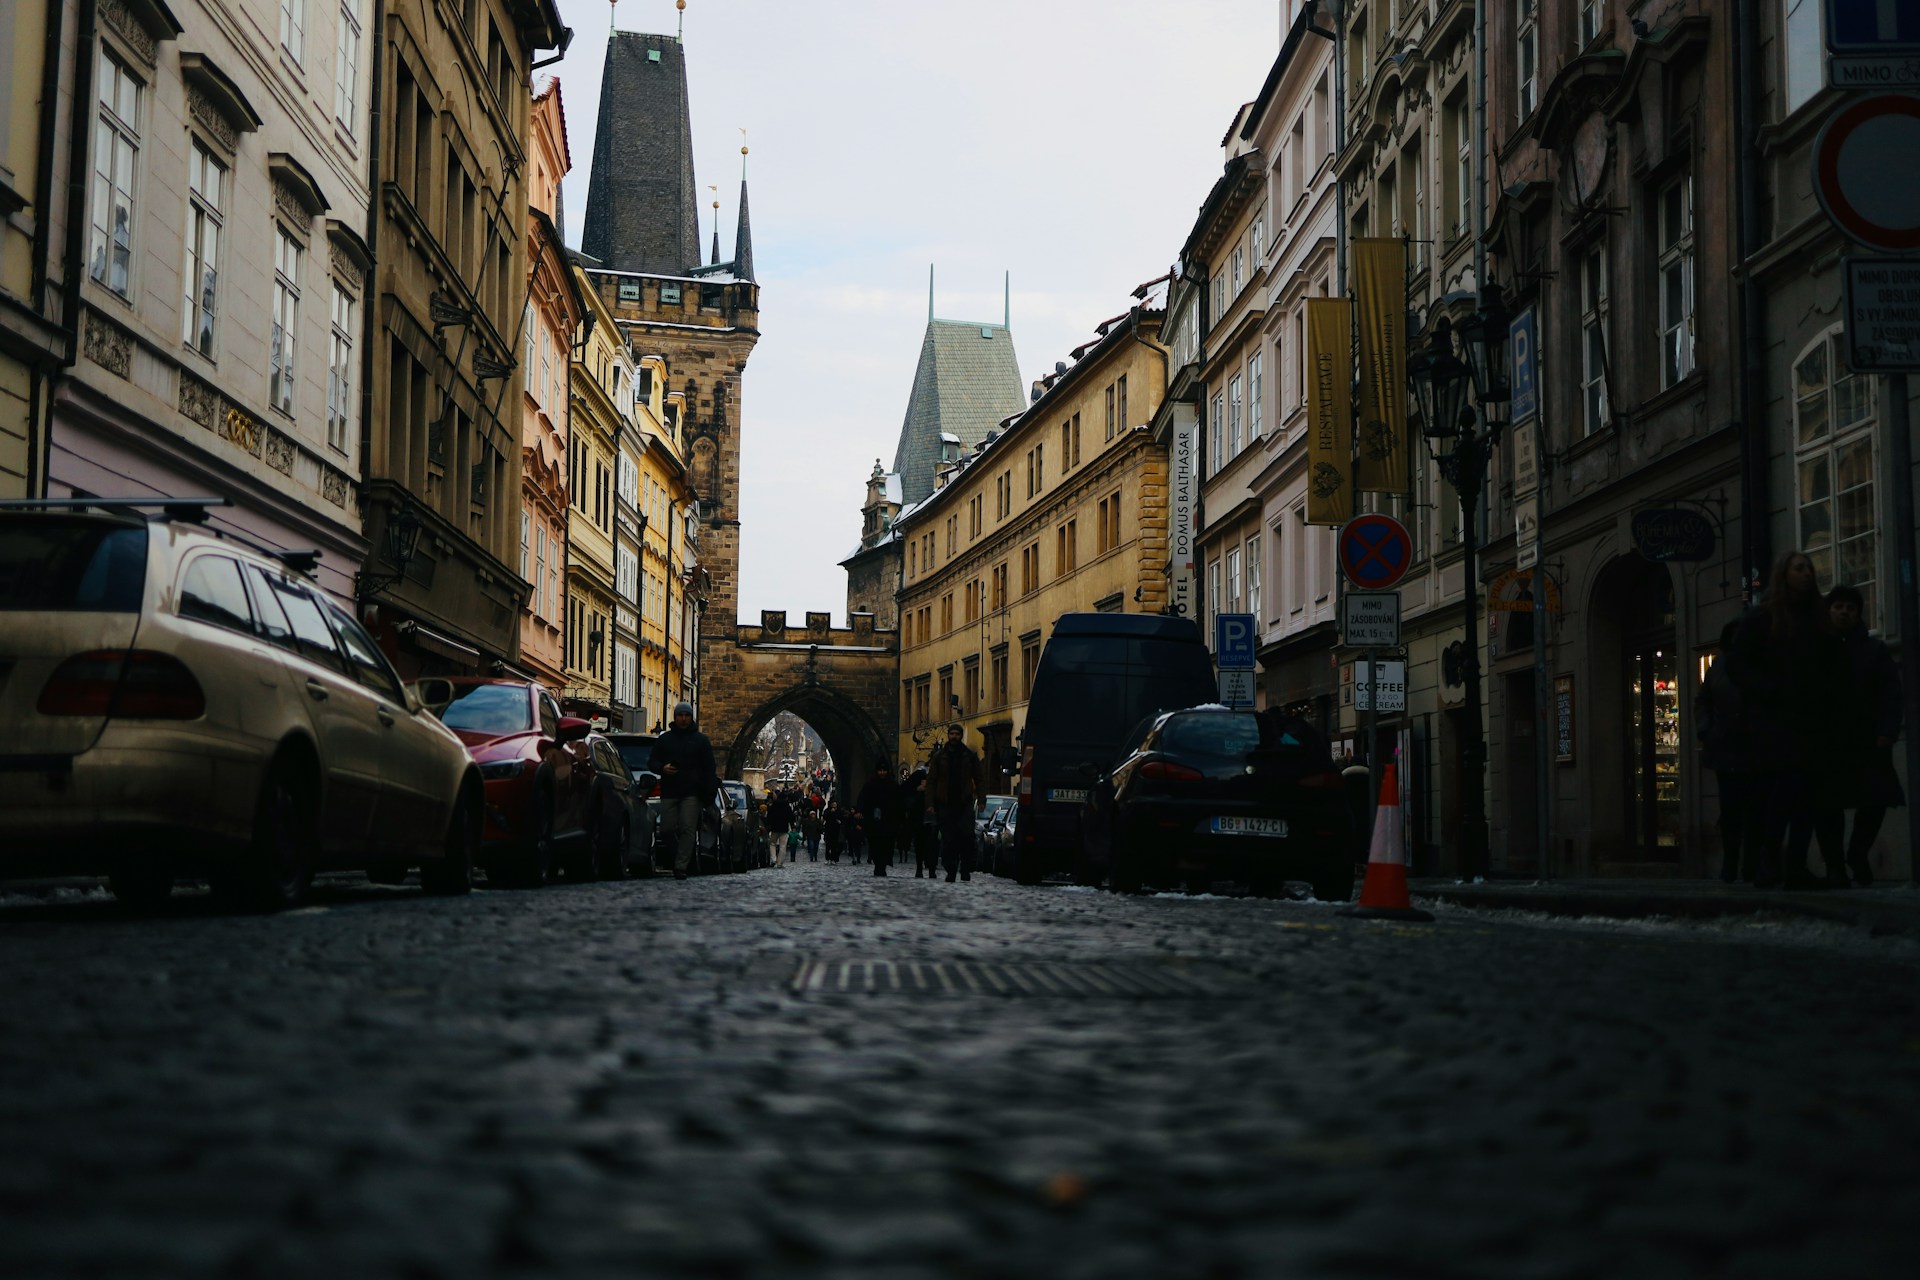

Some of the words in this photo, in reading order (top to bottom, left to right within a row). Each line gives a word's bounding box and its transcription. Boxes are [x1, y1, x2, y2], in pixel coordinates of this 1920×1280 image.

[1843, 65, 1890, 81] MIMO
[1858, 270, 1888, 284] MIMO
[1857, 308, 1864, 322] S
[1319, 353, 1332, 450] RESTAURACE
[1178, 433, 1190, 502] BALTHASAR
[1177, 507, 1188, 555] DOMUS
[1491, 578, 1506, 600] PUB
[1362, 601, 1382, 611] MIMO
[1350, 613, 1395, 625] ZÁSOBOVÁNÍ
[1350, 629, 1367, 639] MAX.
[1369, 629, 1378, 638] 15
[1220, 818, 1234, 829] BG
